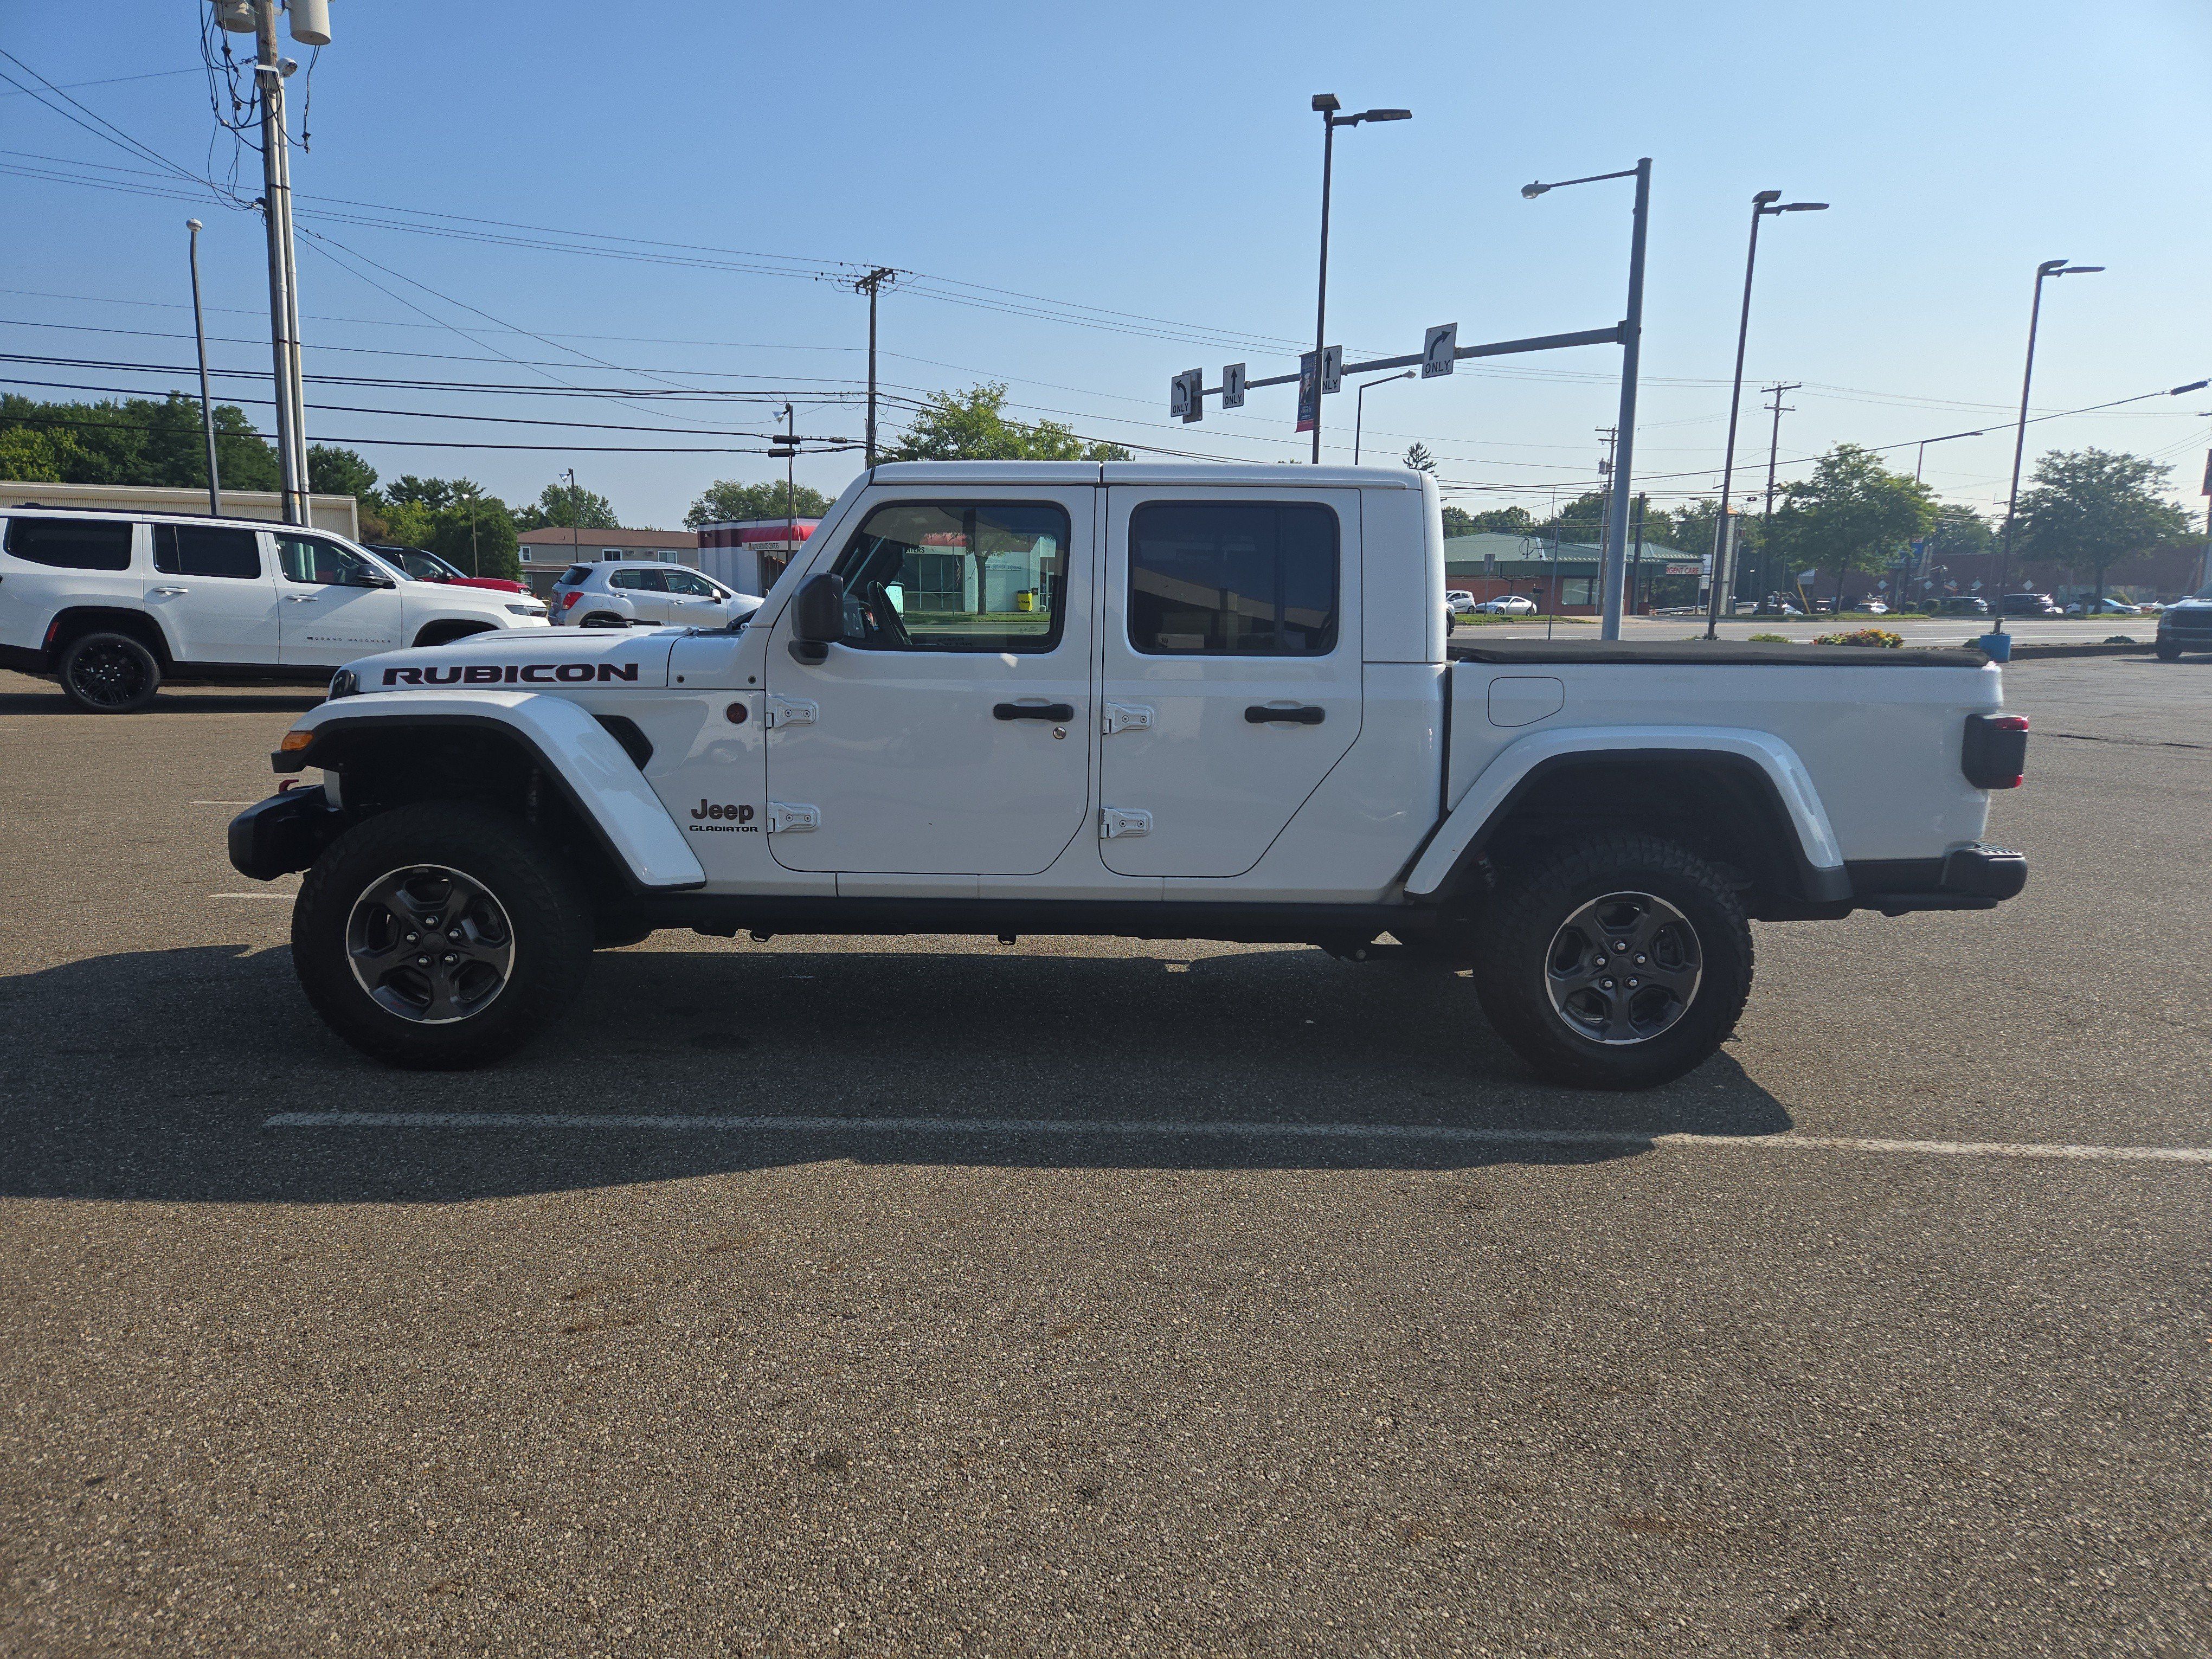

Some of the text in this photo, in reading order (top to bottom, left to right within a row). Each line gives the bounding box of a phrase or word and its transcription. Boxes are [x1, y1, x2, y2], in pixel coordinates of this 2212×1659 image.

[1425, 359, 1451, 374] ONLY
[1322, 379, 1338, 390] NLY
[1224, 394, 1242, 406] ONLY
[1172, 402, 1189, 414] ONLY
[382, 663, 639, 685] RUBICON
[691, 799, 754, 824] Jeep
